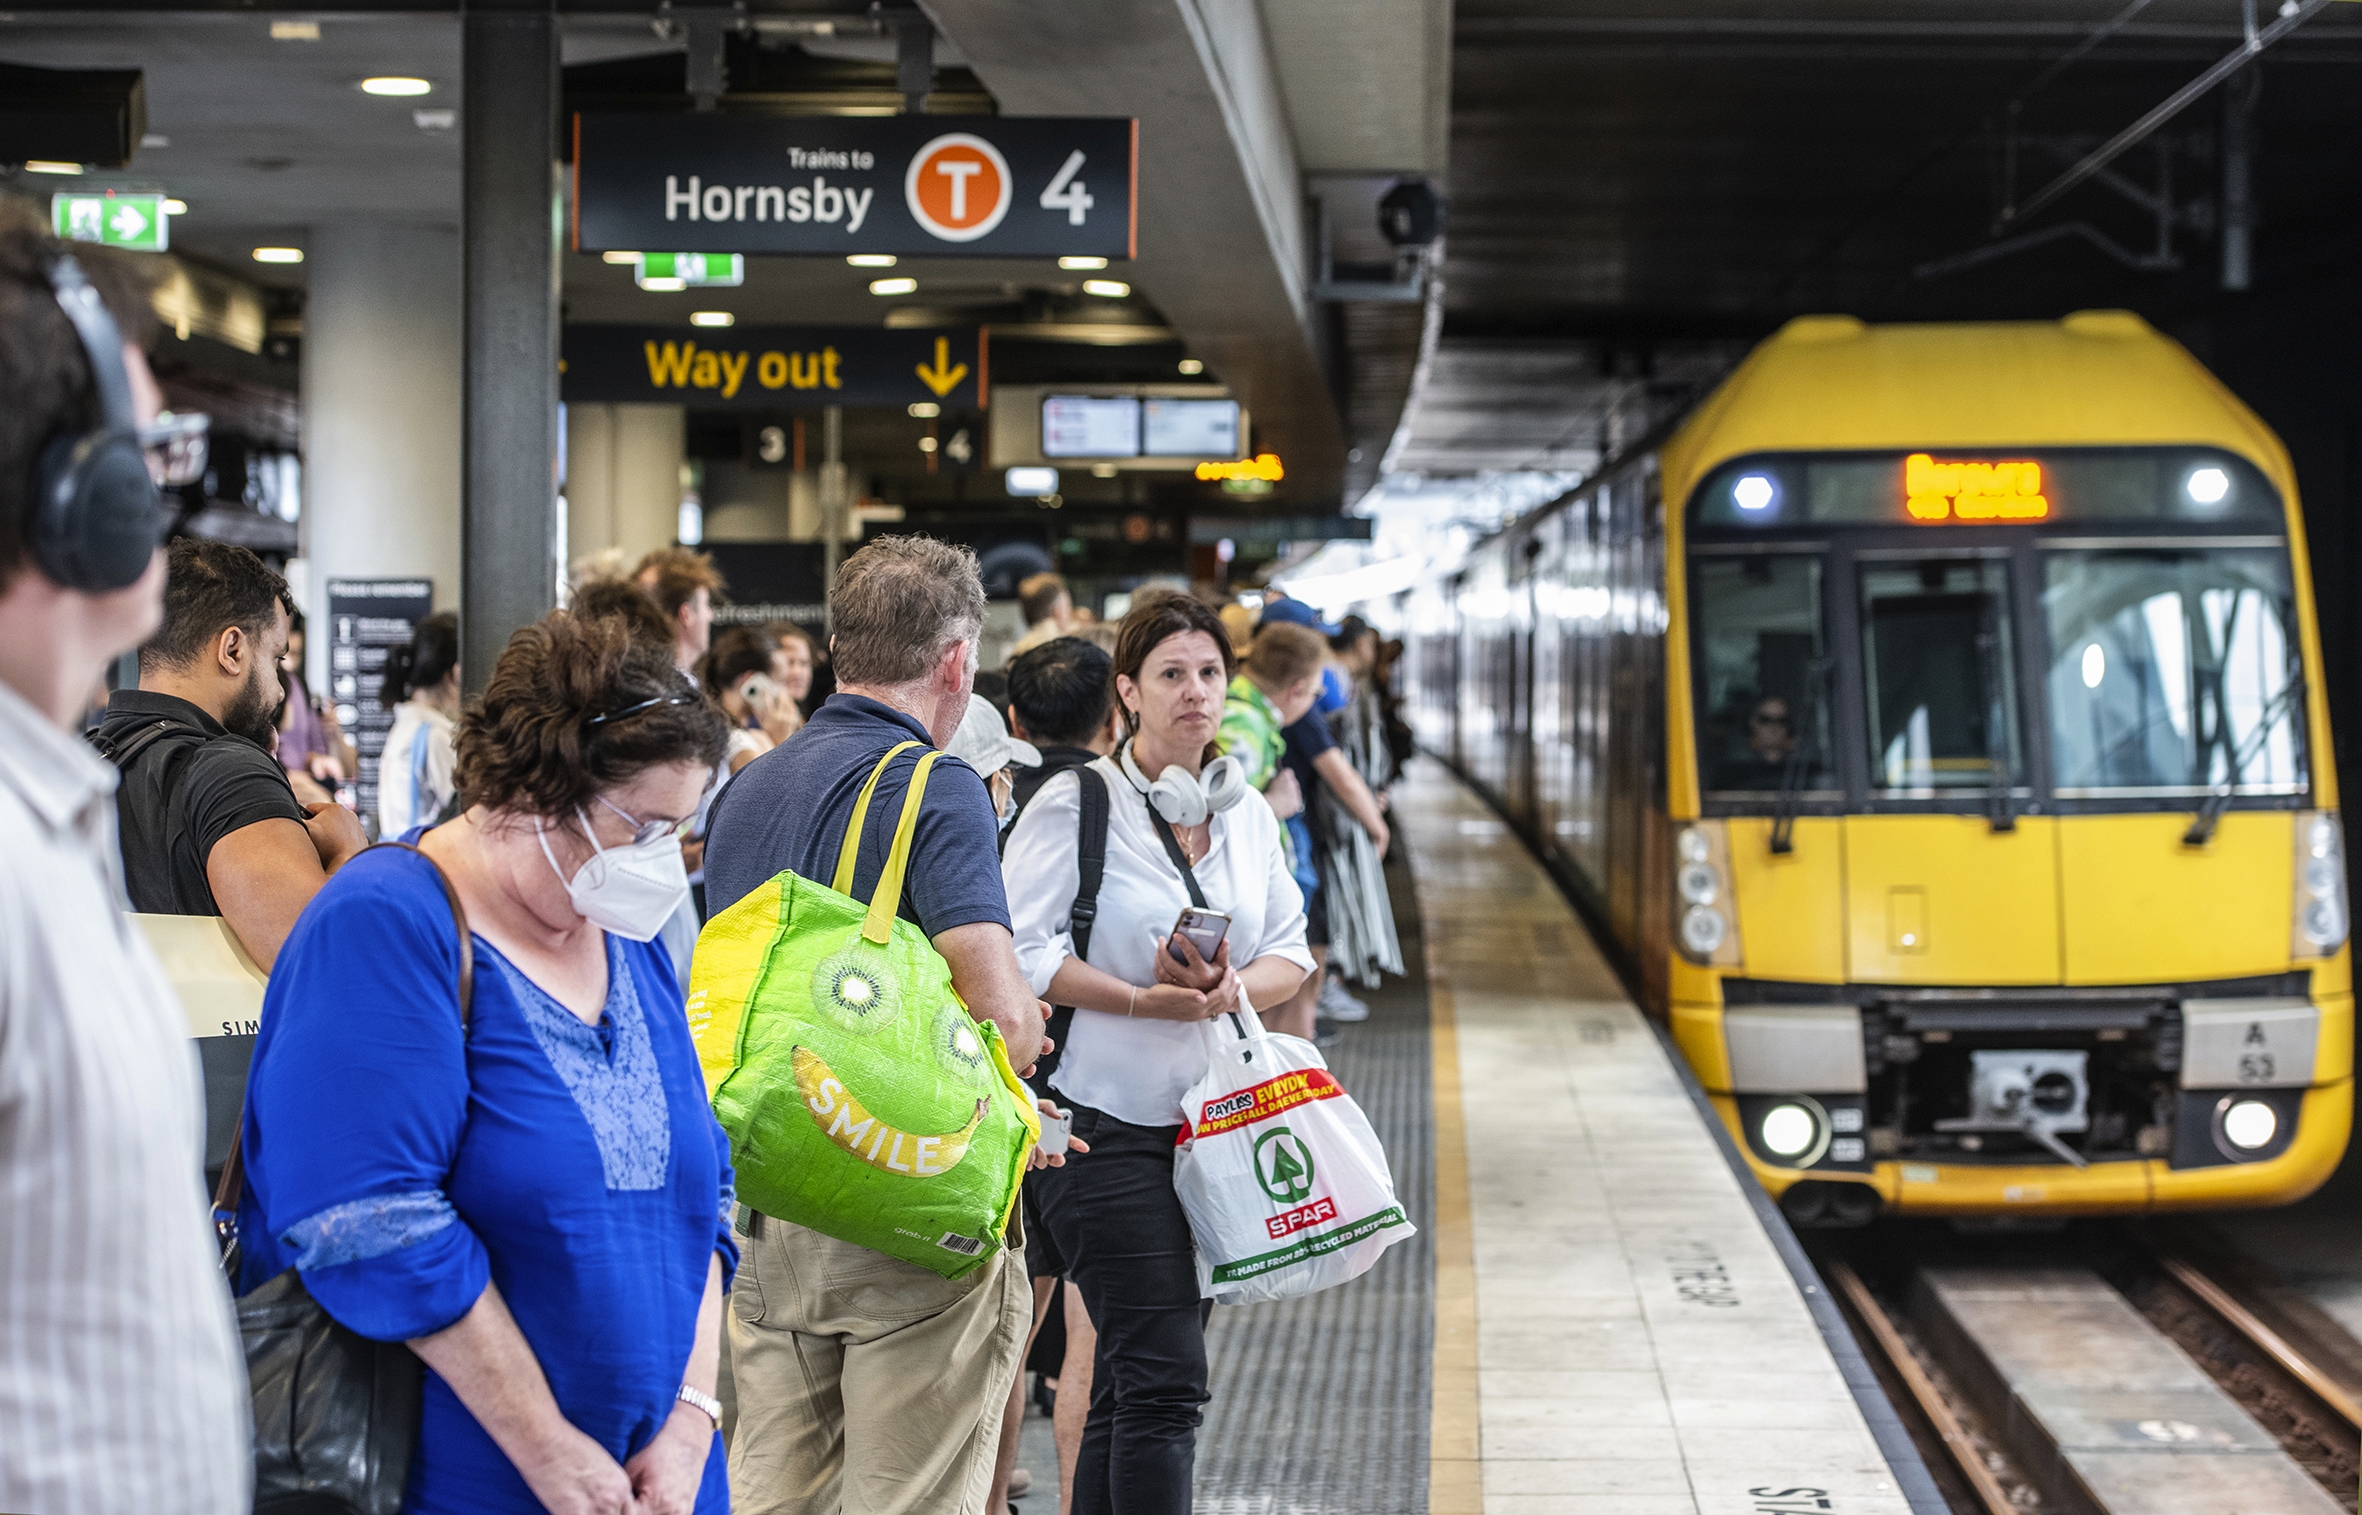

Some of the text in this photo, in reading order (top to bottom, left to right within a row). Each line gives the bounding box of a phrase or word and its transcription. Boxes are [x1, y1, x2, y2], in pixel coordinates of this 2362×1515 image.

[787, 147, 874, 169] Trains to
[665, 175, 873, 234] Hornsby
[936, 161, 981, 221] T
[1040, 149, 1094, 225] 4
[644, 339, 842, 399] Way out
[759, 425, 786, 463] 3
[946, 428, 973, 464] 4
[2245, 1020, 2266, 1045] A
[810, 1078, 941, 1173] SMILE
[1249, 1106, 1268, 1118] ALL
[894, 1227, 921, 1239] grab
[1269, 1201, 1334, 1236] SPAR
[1237, 1261, 1266, 1276] MADE
[1267, 1253, 1293, 1267] FROM
